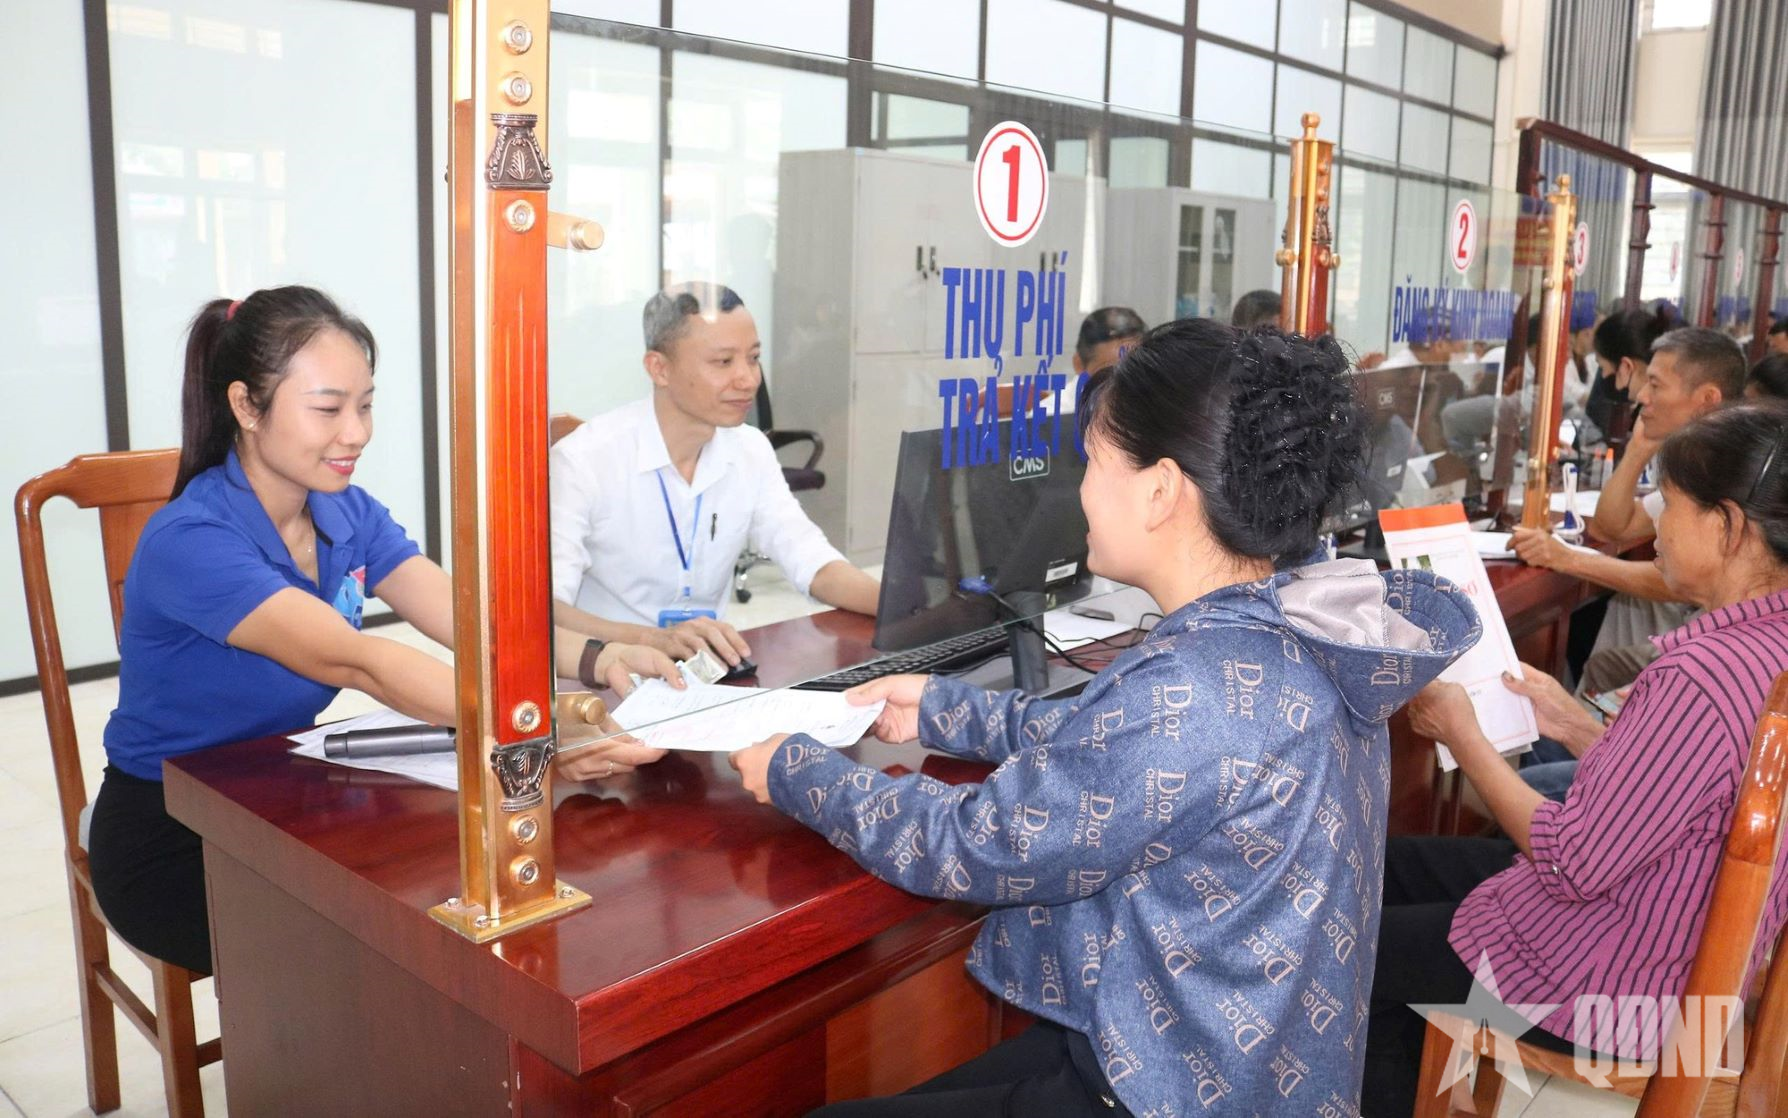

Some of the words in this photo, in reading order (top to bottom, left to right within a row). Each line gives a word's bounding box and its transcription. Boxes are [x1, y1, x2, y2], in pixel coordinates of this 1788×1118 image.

[1002, 145, 1021, 222] 1
[1457, 212, 1469, 259] 2
[1577, 231, 1586, 265] 3
[1014, 250, 1068, 357] PHÍ
[939, 355, 1003, 470] TRẢ
[1009, 351, 1067, 459] KẾT
[1013, 455, 1045, 475] CMS
[1386, 569, 1405, 615] Dio
[1222, 659, 1235, 717] CHRISTAL
[1235, 660, 1264, 720] Dior
[1284, 685, 1314, 705] CHRIS
[1371, 653, 1400, 687] Dior
[933, 700, 970, 735] Dior
[1024, 707, 1062, 742] Dior
[1150, 685, 1162, 738] CHRISTAL
[1163, 682, 1193, 742] Dior
[1144, 768, 1156, 822] CHRISTAL
[1157, 768, 1187, 823] Dior
[1252, 765, 1301, 807] Dior
[856, 796, 901, 832] Dior
[974, 805, 1000, 845] Dio
[1018, 805, 1050, 863] Dior
[1086, 791, 1115, 849] Dior
[894, 828, 926, 874] Dior
[1222, 825, 1277, 871] Dior
[1184, 871, 1233, 923] Dior
[1081, 932, 1101, 988] Dior
[1152, 923, 1196, 979] Dior
[1243, 934, 1296, 986] Dior
[1259, 923, 1303, 966] CHRISTAL
[1322, 918, 1356, 966] Dior
[1040, 952, 1062, 1006] Dior
[1135, 979, 1175, 1036] Dior
[1216, 998, 1268, 1056] Dior
[1233, 989, 1276, 1035] CHRISTAL
[1301, 989, 1338, 1036] Dior
[1099, 1030, 1134, 1087] Dior
[1107, 1022, 1143, 1071] CHRISTAL
[1197, 1044, 1233, 1093] CHRISTAL
[1182, 1051, 1226, 1110] Dior
[1270, 1056, 1304, 1098] Dior
